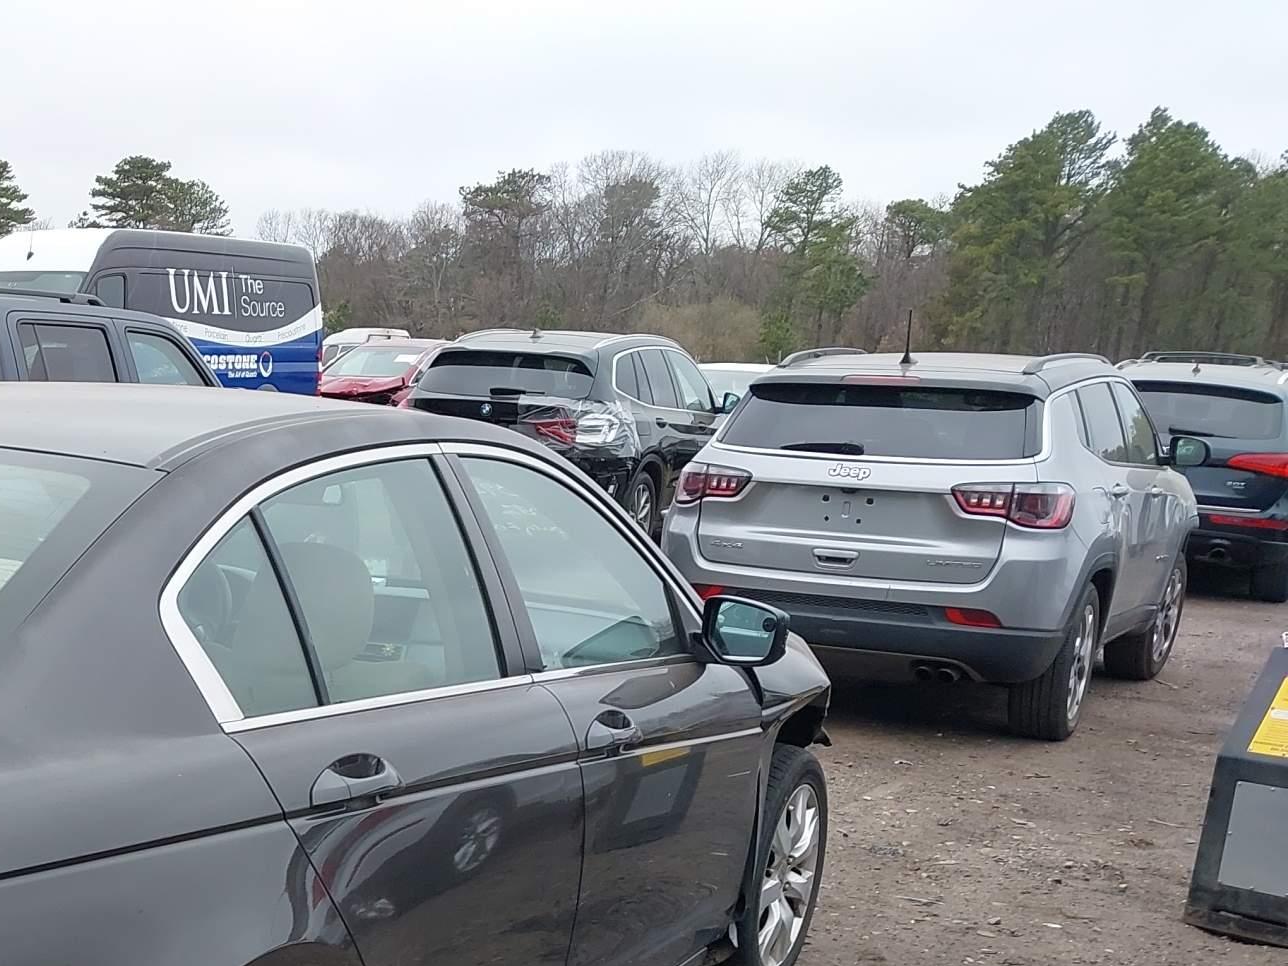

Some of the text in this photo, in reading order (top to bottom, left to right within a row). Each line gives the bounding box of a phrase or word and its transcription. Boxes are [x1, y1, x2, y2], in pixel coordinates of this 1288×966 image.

[166, 268, 232, 315] UMI
[239, 275, 264, 294] The
[241, 296, 285, 317] Source
[828, 463, 872, 481] Jeep
